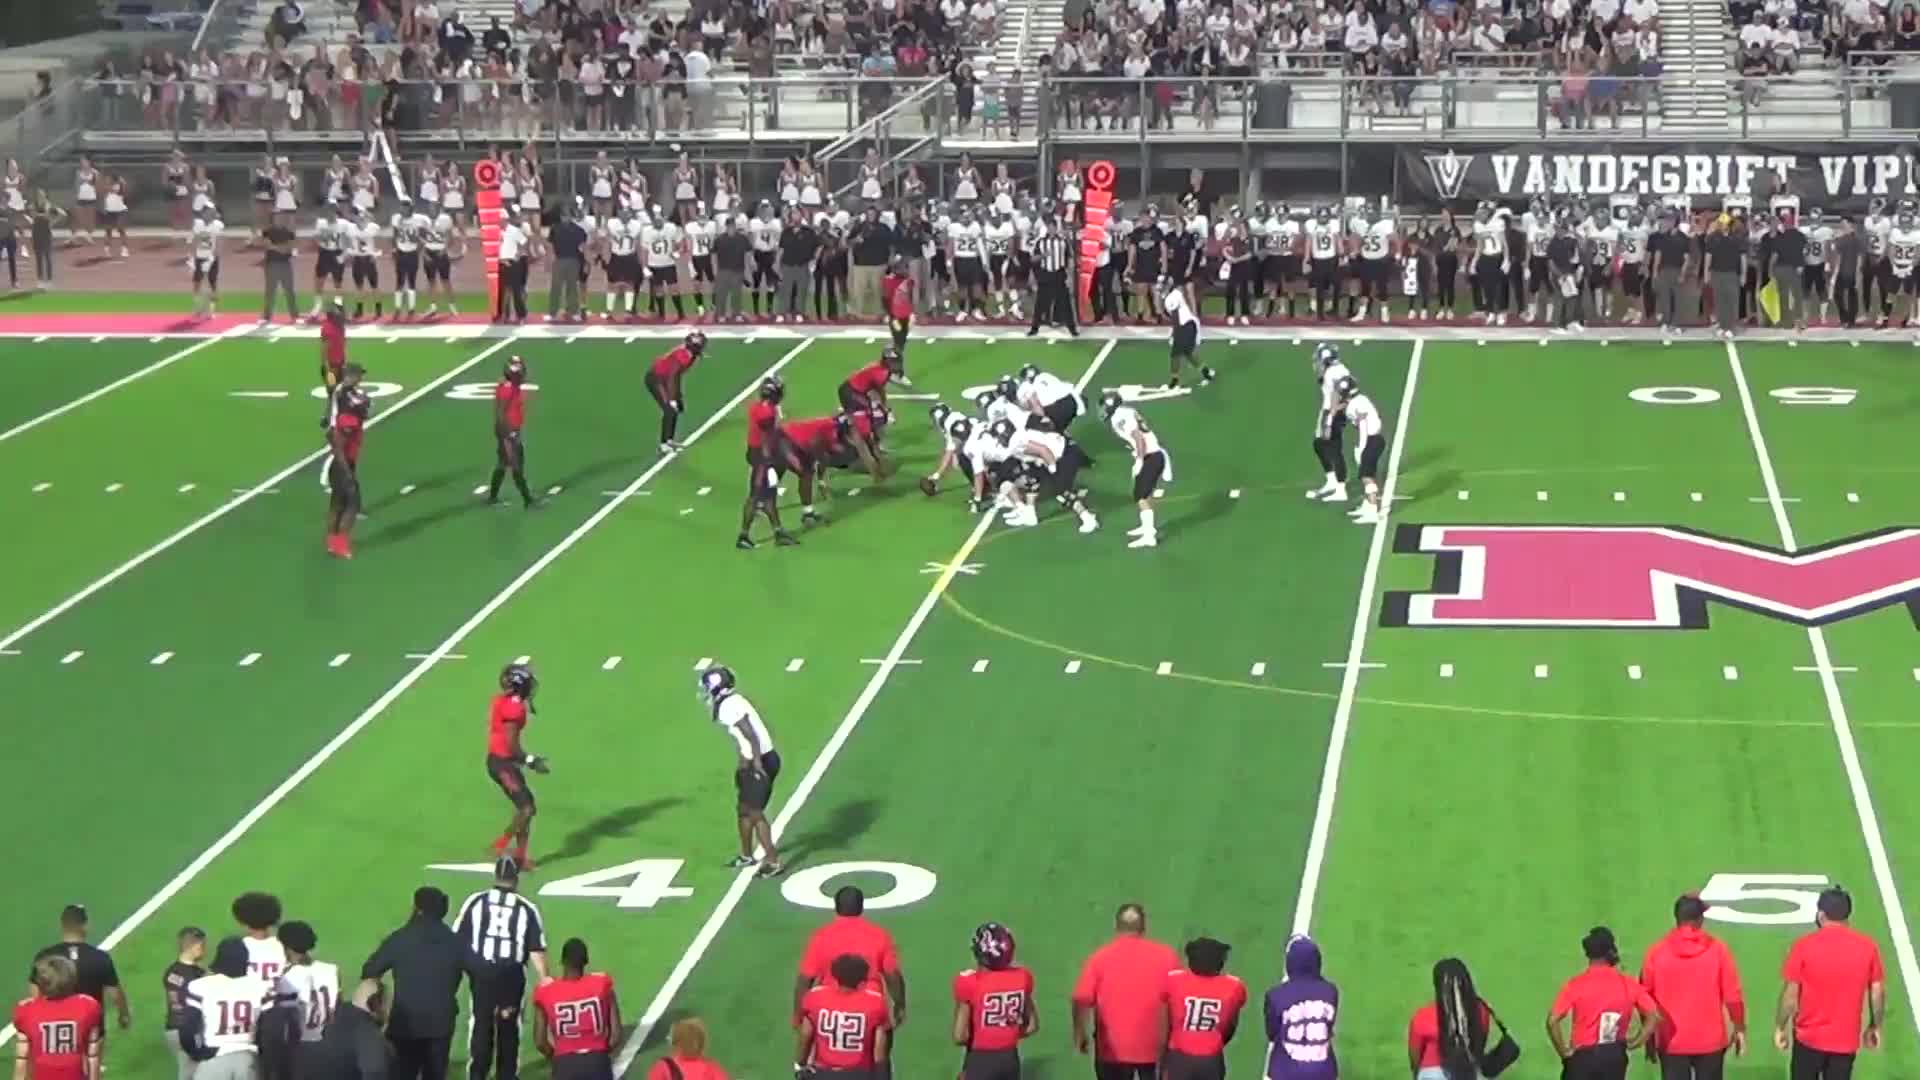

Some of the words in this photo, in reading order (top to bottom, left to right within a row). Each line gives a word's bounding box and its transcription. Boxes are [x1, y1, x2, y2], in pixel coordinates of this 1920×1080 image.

[1491, 155, 1797, 195] VANDEGRIFT
[555, 997, 605, 1038] 27
[817, 1008, 865, 1051] 42
